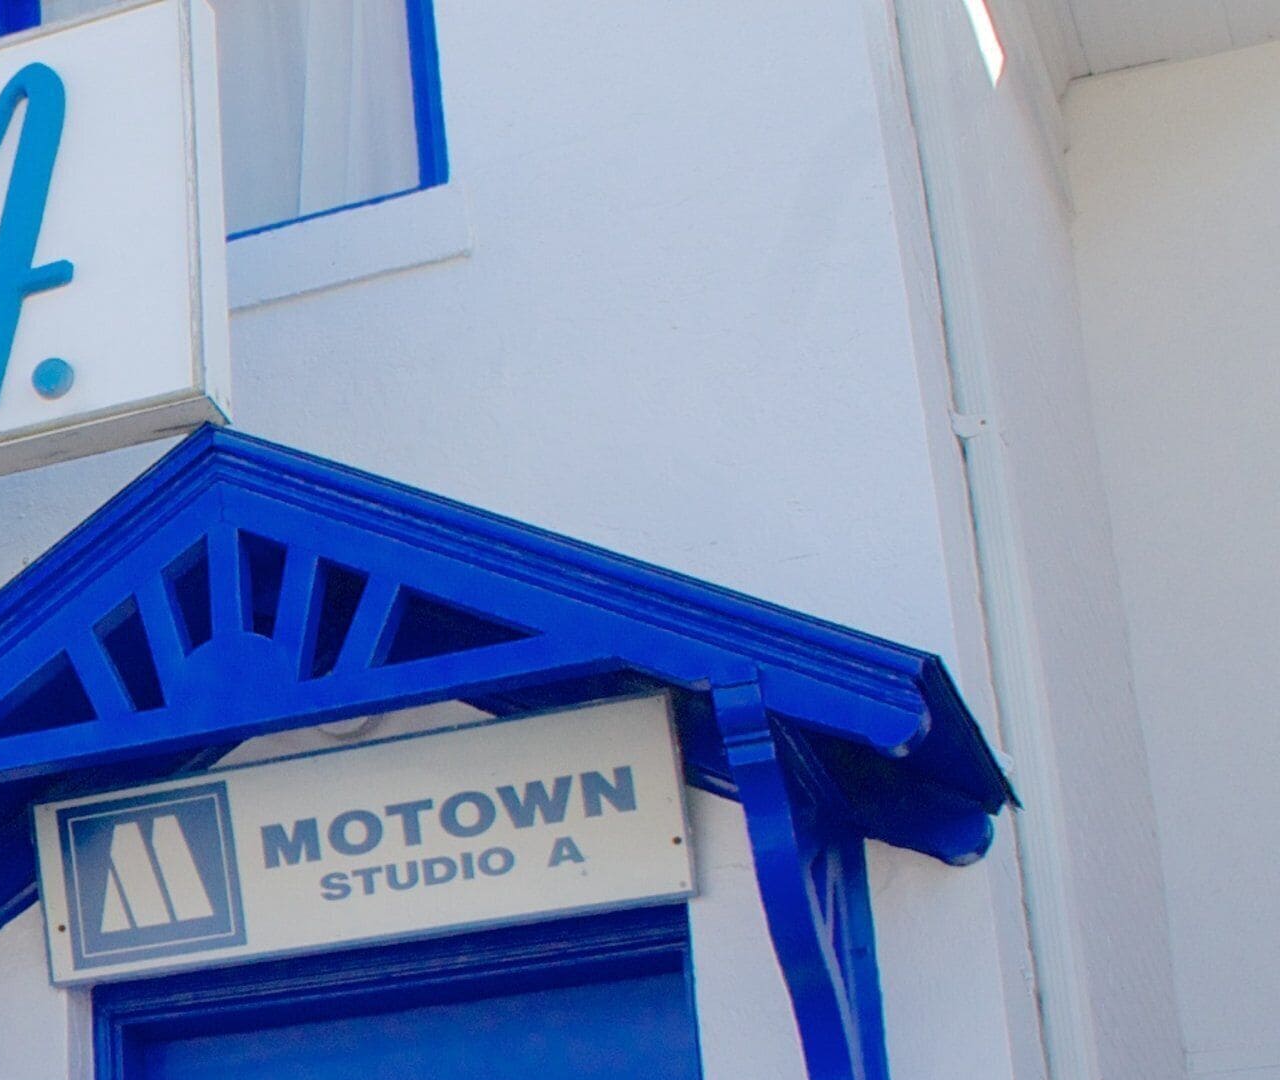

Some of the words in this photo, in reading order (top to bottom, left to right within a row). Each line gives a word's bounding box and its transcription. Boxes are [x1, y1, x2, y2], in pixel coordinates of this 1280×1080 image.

[259, 765, 638, 869] MOTOWN
[319, 845, 516, 902] STUDIO
[547, 836, 586, 868] A
